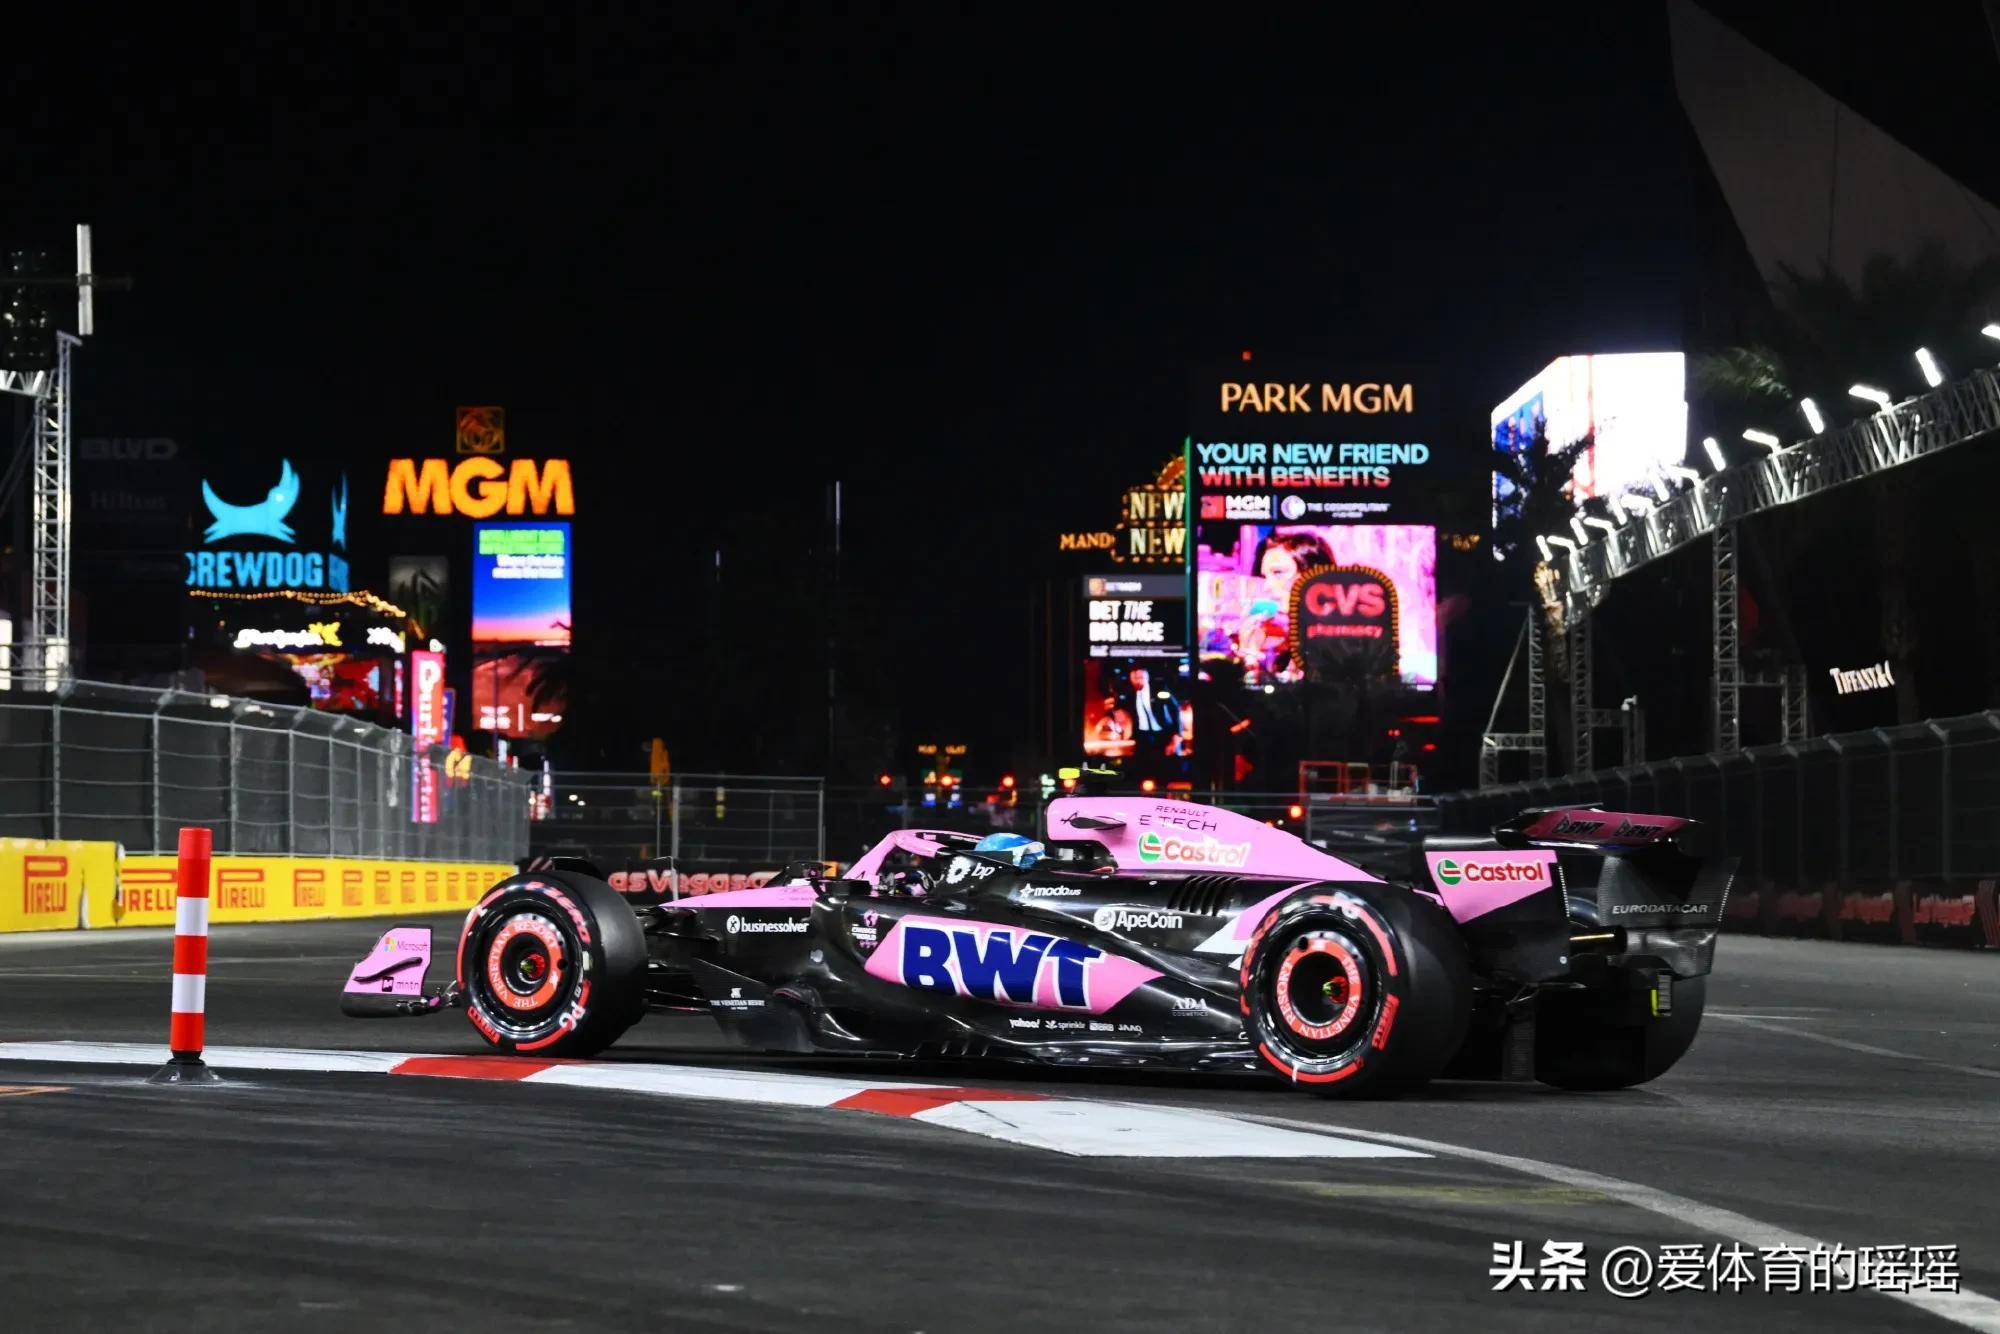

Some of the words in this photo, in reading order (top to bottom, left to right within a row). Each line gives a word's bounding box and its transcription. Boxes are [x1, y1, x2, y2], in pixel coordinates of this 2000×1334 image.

[1221, 382, 1311, 413] PARK
[1321, 382, 1413, 414] MGM
[1197, 443, 1267, 465] YOUR
[1273, 443, 1332, 465] NEW
[1339, 443, 1430, 466] FRIEND
[1198, 465, 1266, 488] WITH
[1270, 465, 1392, 488] BENEFITS
[383, 456, 576, 519] MGM
[1129, 491, 1186, 520] NEW
[1225, 494, 1271, 511] MGM
[1129, 527, 1187, 555] NEW
[1305, 582, 1385, 617] CVS
[1089, 600, 1121, 620] BET
[1123, 600, 1153, 620] THE
[1120, 621, 1165, 641] RACE
[1154, 804, 1210, 817] RENAULT
[1164, 838, 1248, 865] Castrol
[971, 862, 996, 880] bp
[1464, 862, 1544, 882] Castrol
[1612, 904, 1708, 915] EURODATACAR
[741, 916, 810, 933] businessolver
[1116, 911, 1183, 931] ApeCoin
[902, 924, 1104, 1008] BWT
[1009, 1018, 1041, 1029] yahoo!
